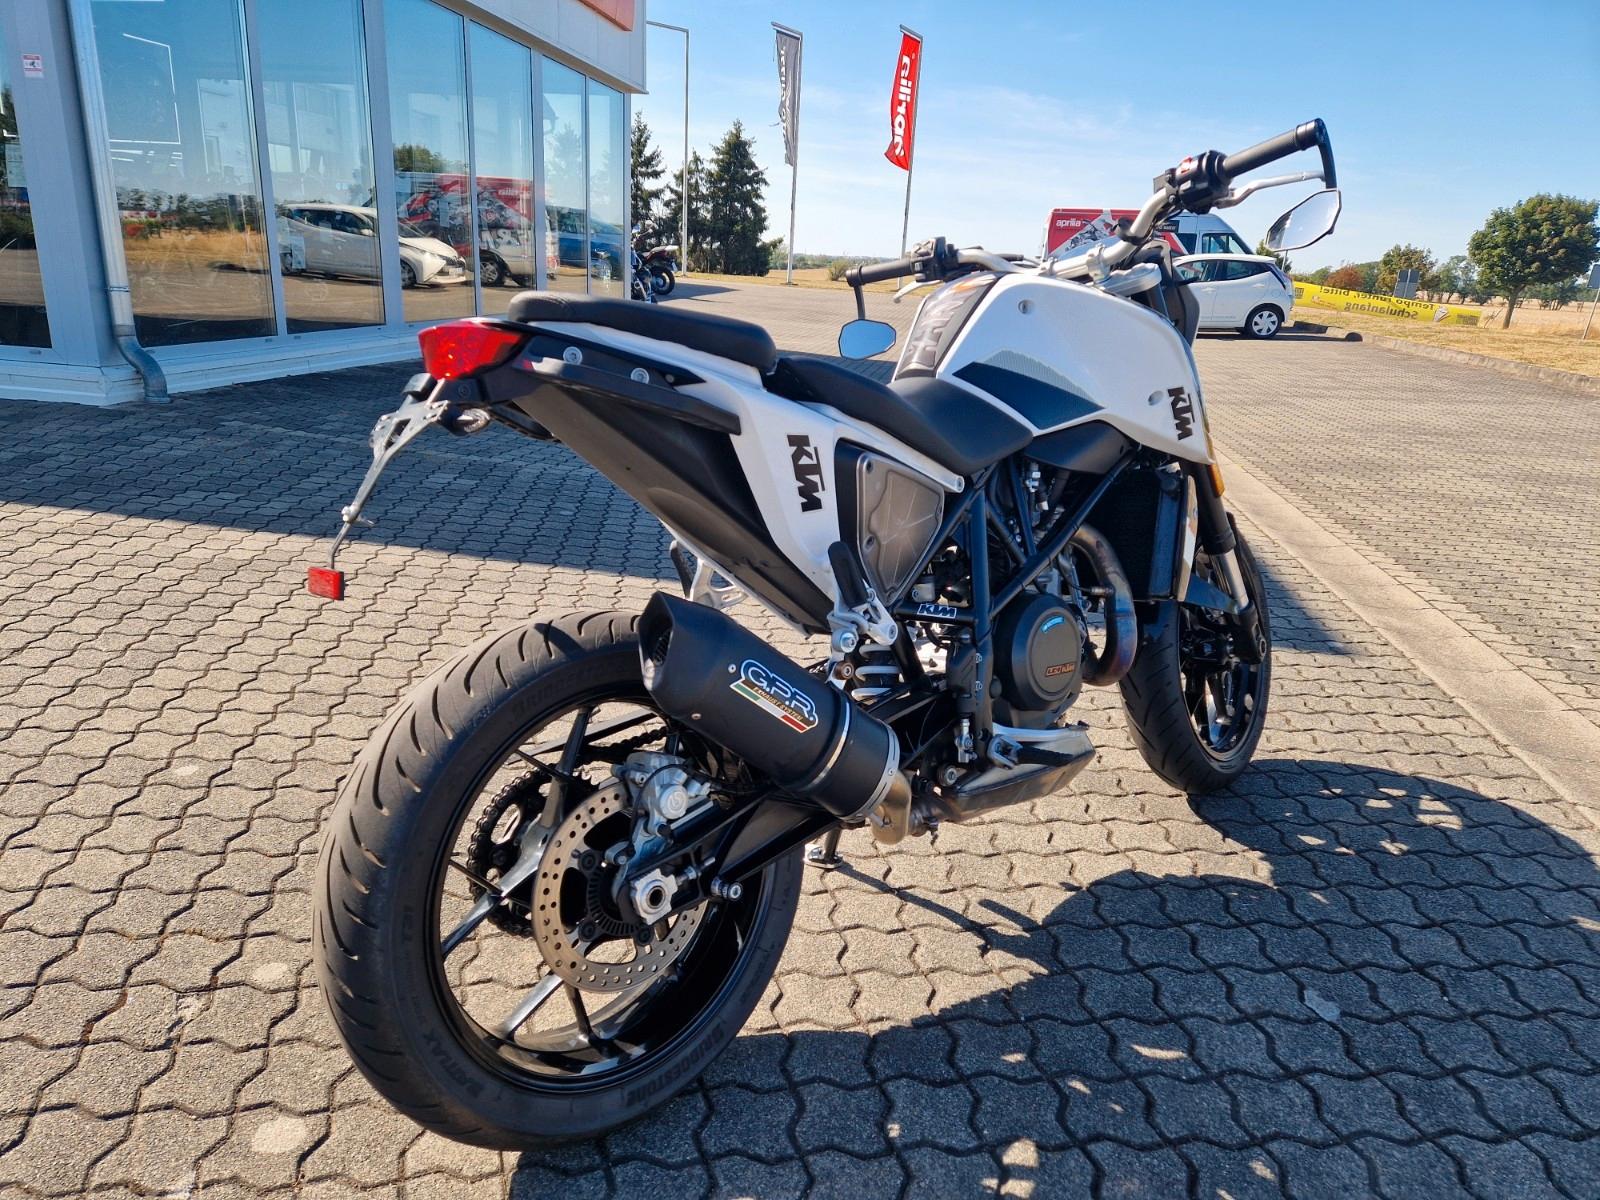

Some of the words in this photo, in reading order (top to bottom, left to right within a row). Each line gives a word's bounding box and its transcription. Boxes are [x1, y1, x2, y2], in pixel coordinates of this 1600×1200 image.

[1056, 217, 1082, 228] aprilia
[1167, 386, 1196, 441] KTM
[786, 434, 826, 513] KTM
[917, 603, 957, 619] KTM
[752, 686, 780, 706] EXHAUST
[779, 704, 804, 721] SYSTEM
[626, 1023, 726, 1108] BRIDGESTONE
